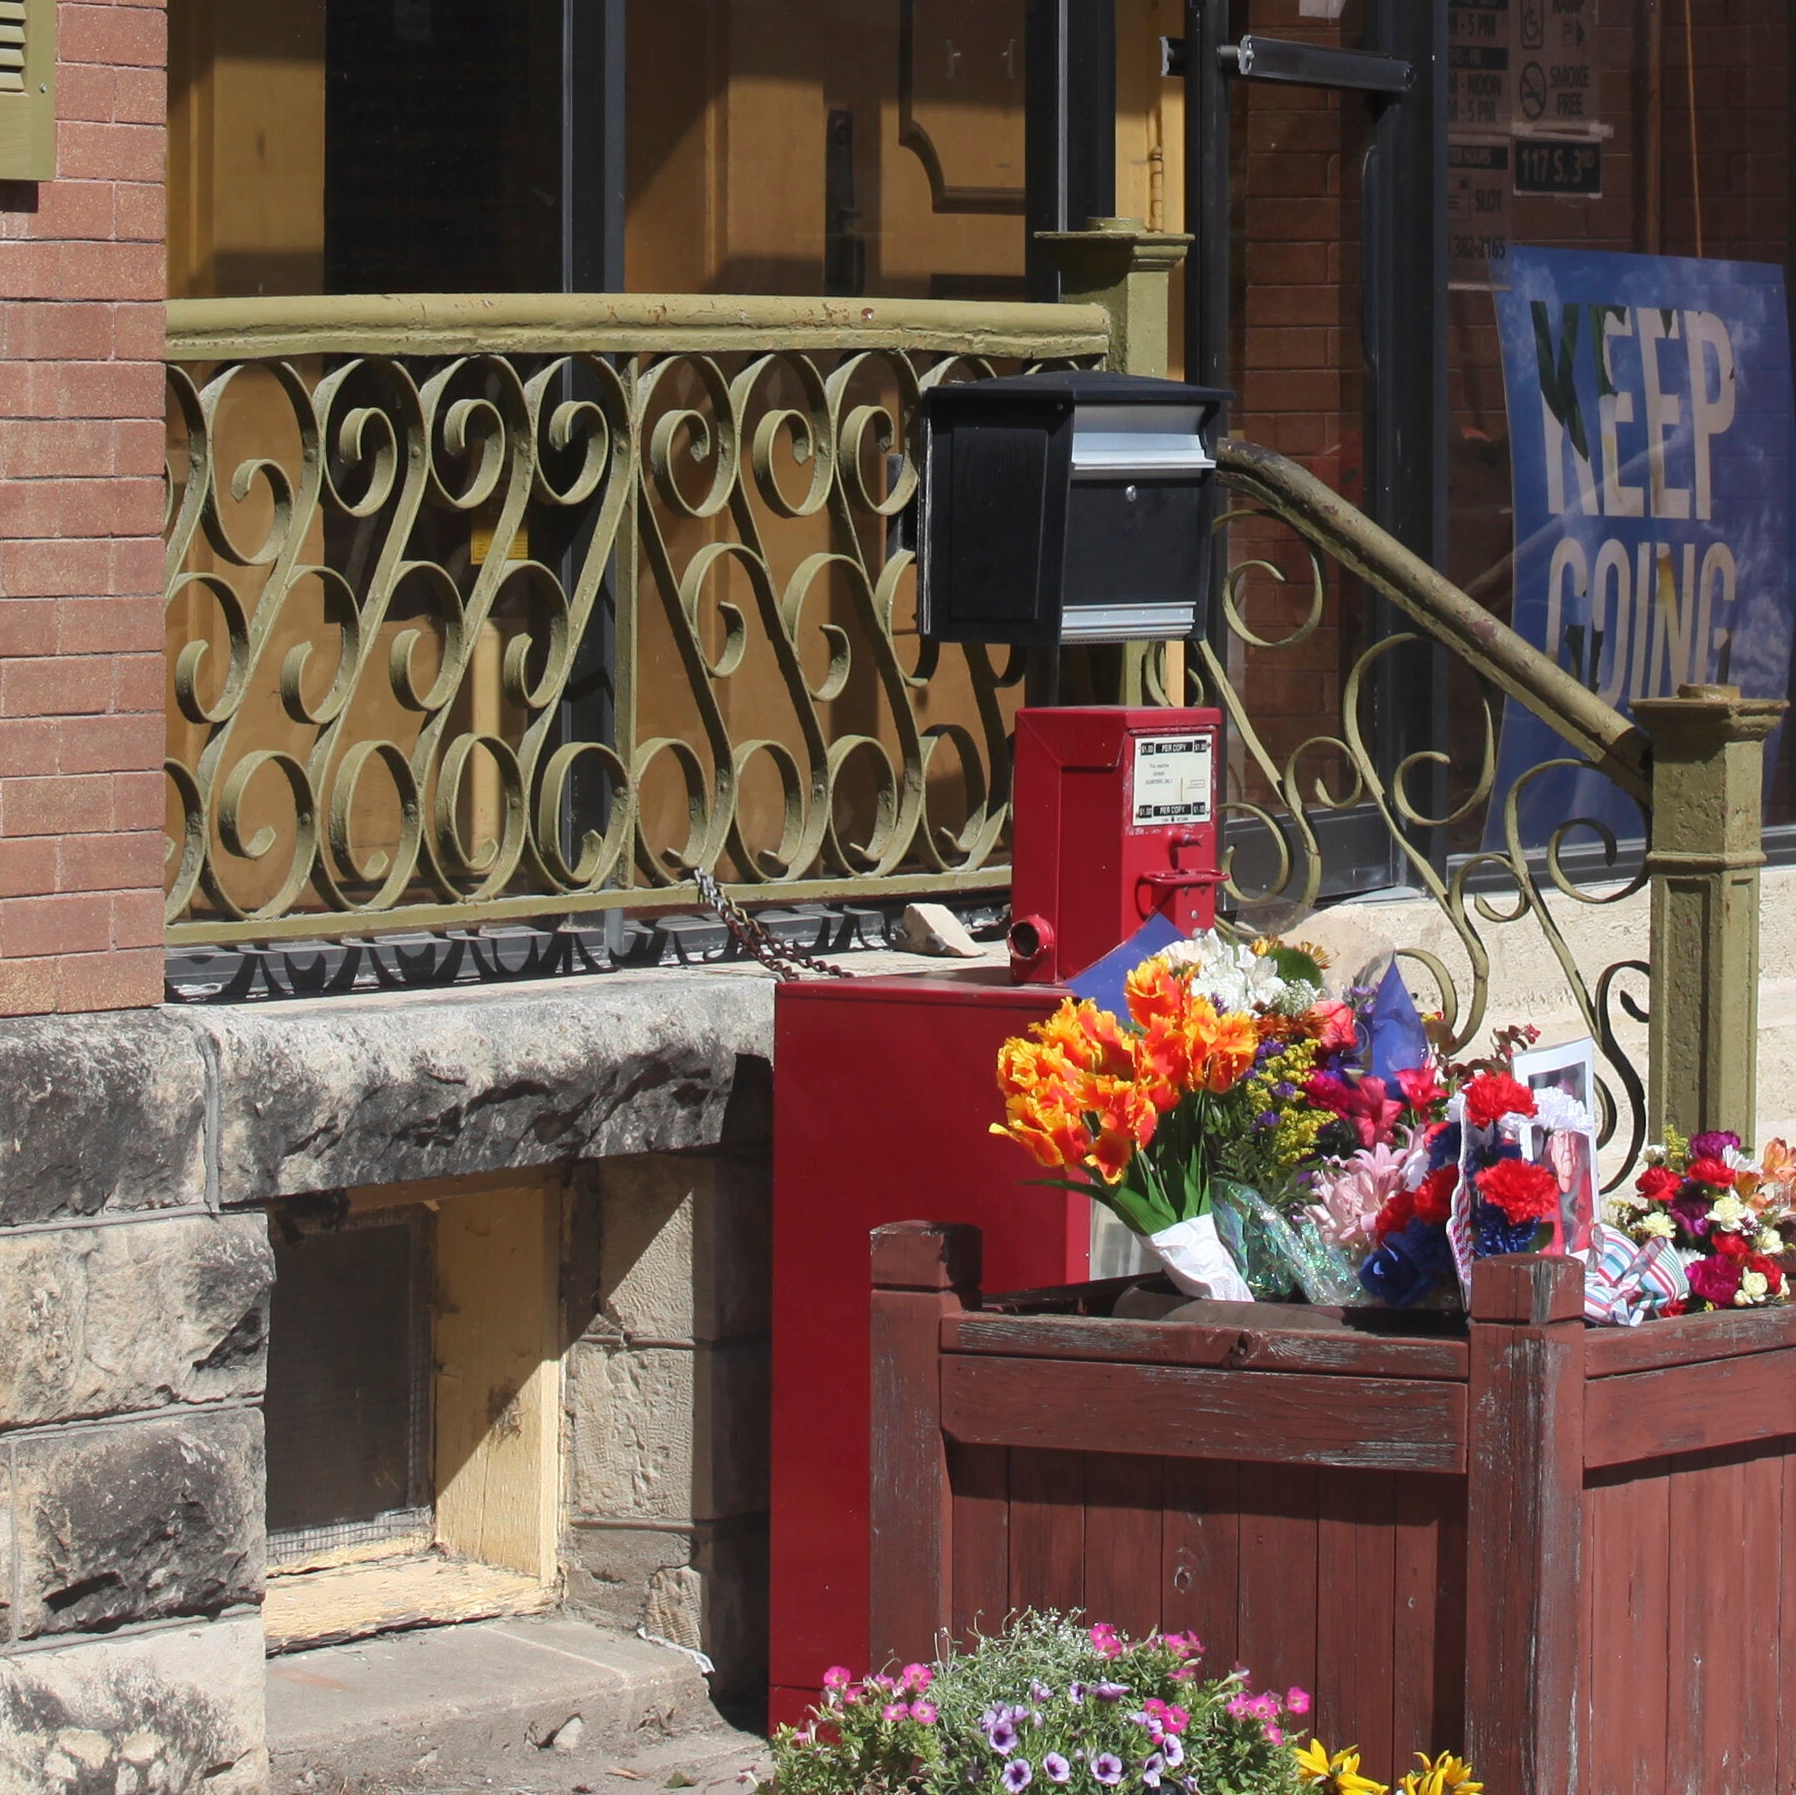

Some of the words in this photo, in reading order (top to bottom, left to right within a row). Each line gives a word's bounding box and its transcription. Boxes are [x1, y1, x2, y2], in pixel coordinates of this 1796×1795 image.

[1469, 12, 1475, 36] 5
[1478, 13, 1496, 36] PM
[1468, 73, 1501, 97] NOON
[1550, 65, 1589, 88] SMOKE
[1478, 100, 1496, 122] PM
[1557, 93, 1583, 116] FREE
[1521, 148, 1549, 182] 117
[1554, 148, 1568, 183] S.
[1475, 189, 1503, 212] SLOT
[1530, 300, 1735, 521] KEEP
[1545, 537, 1736, 707] GOING
